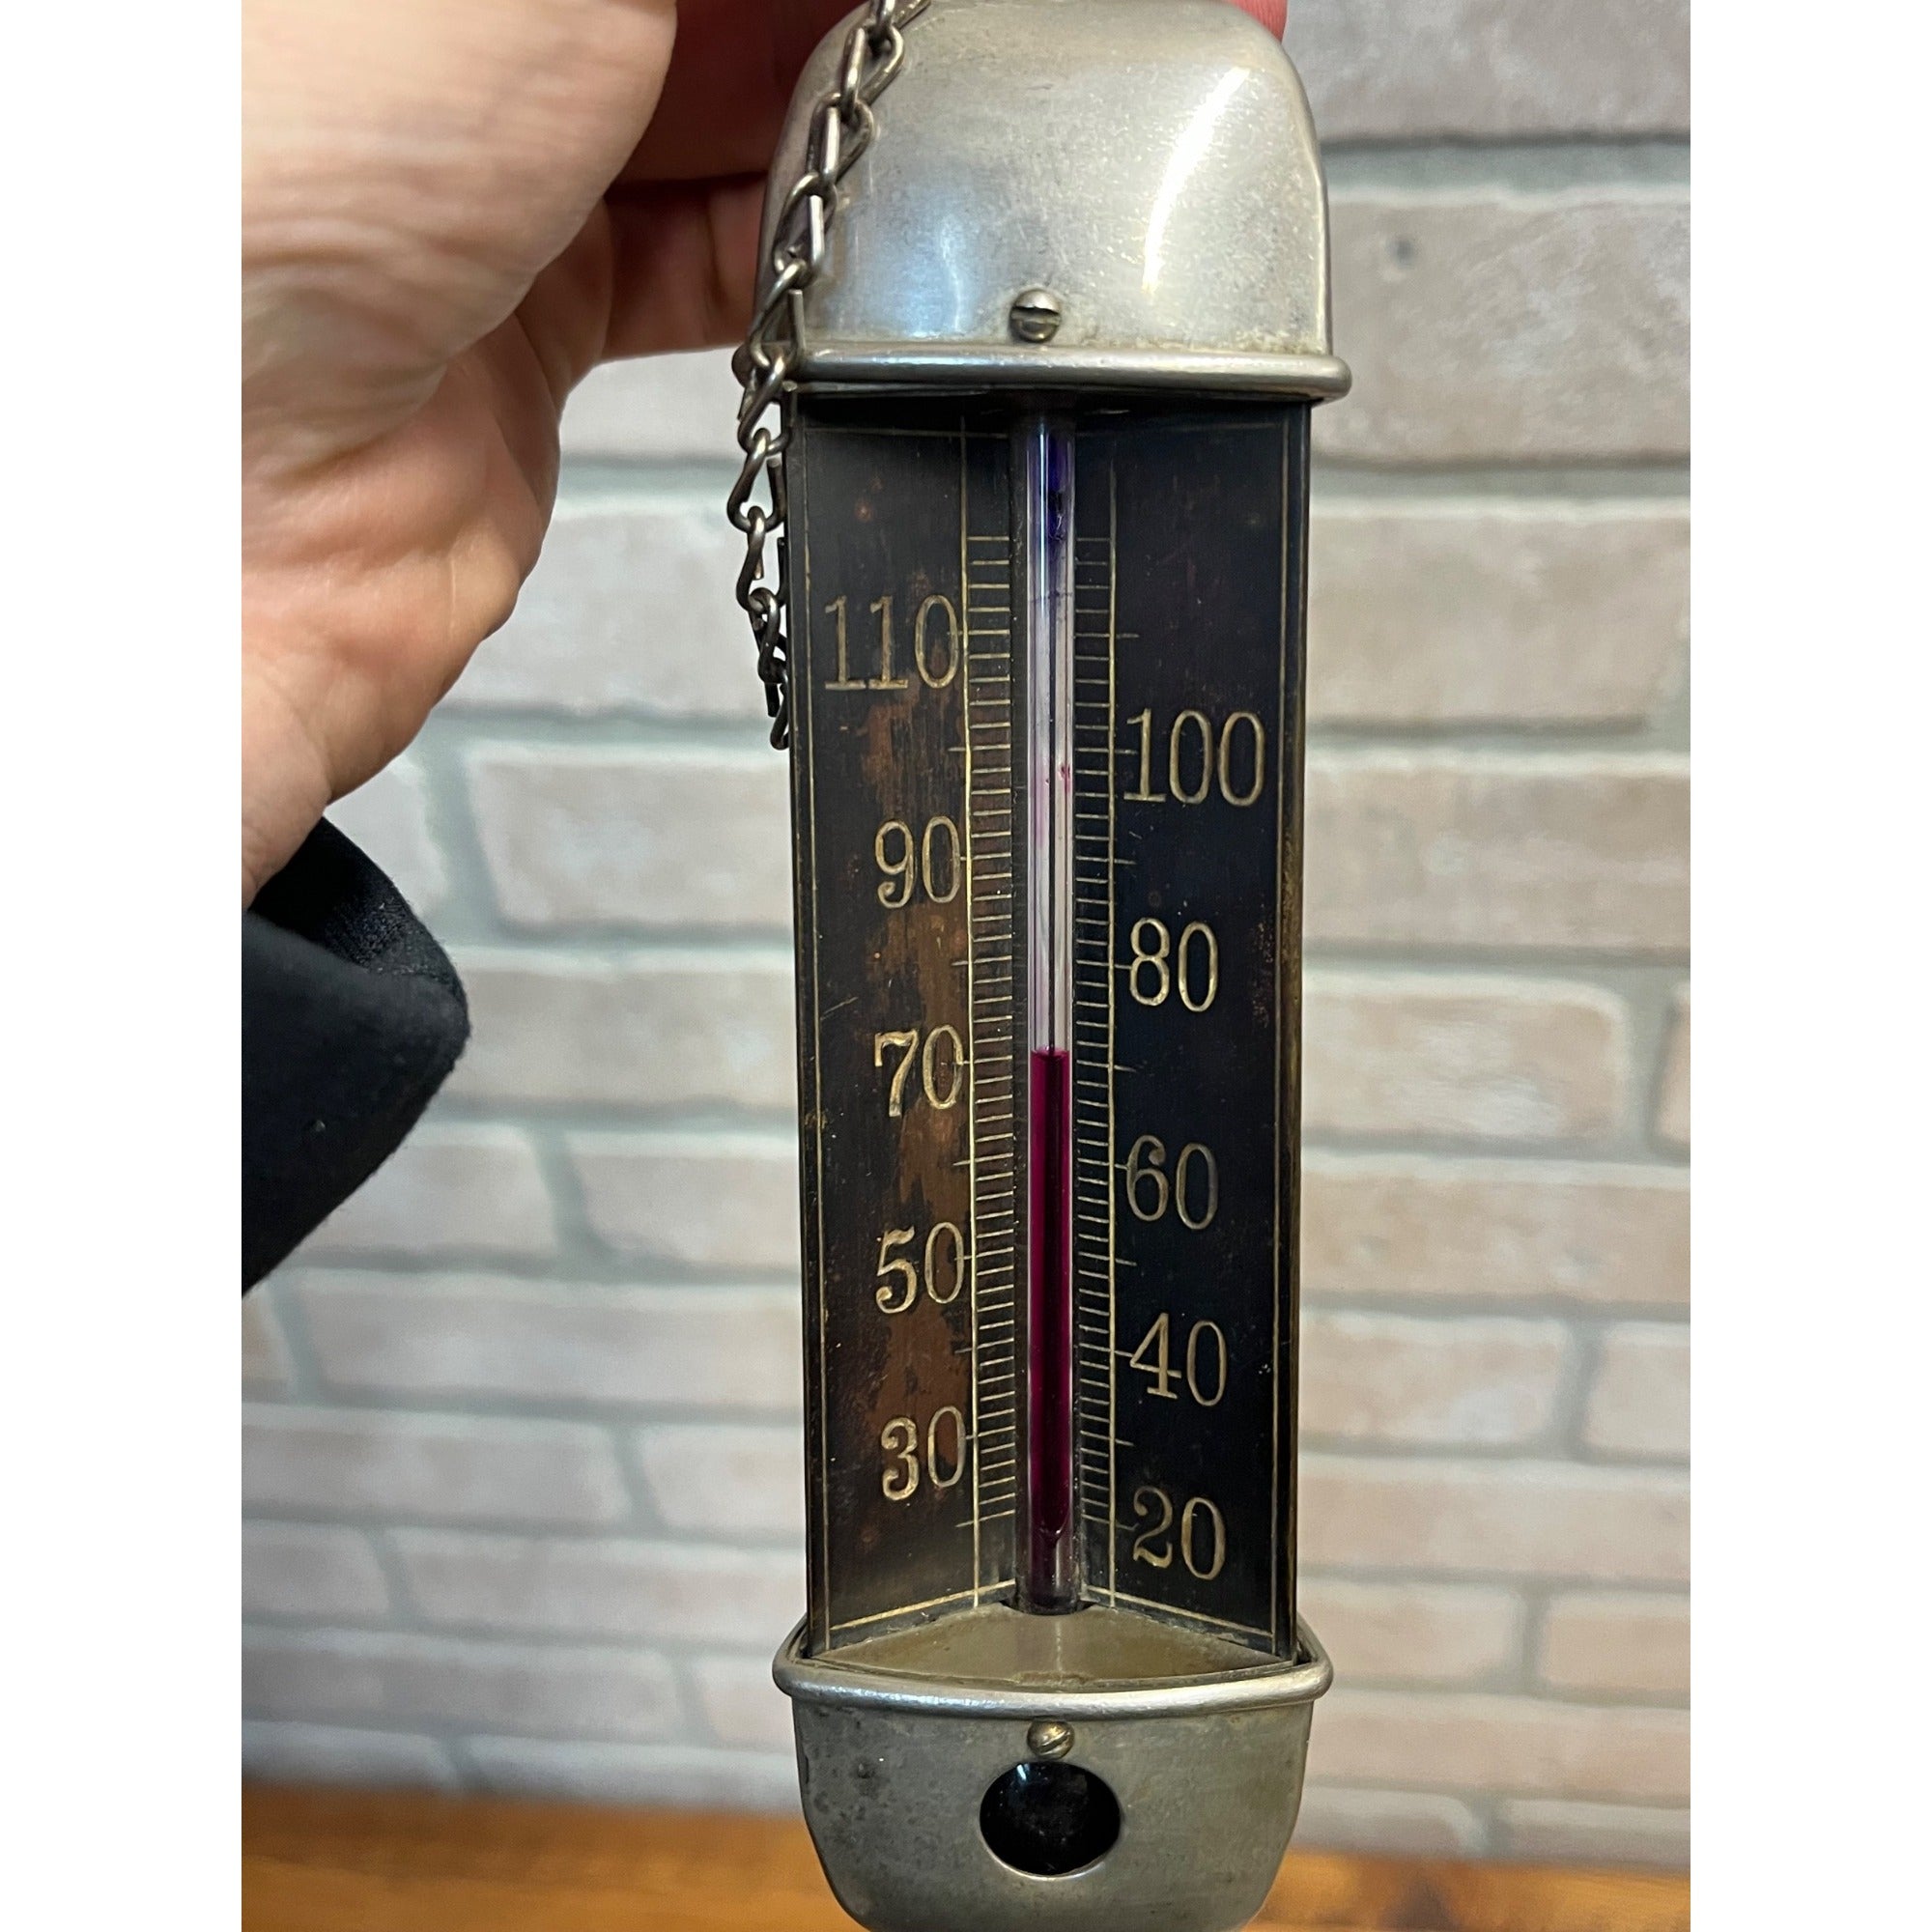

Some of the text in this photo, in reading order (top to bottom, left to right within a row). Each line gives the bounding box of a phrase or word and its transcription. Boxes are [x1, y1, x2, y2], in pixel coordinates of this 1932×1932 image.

[825, 595, 960, 690] 110
[1123, 708, 1265, 808] 100
[874, 816, 961, 909] 90
[1129, 918, 1218, 1012] 80
[874, 1025, 964, 1117] 70
[1126, 1134, 1219, 1231] 60
[875, 1221, 964, 1314] 50
[1128, 1313, 1228, 1407] 40
[881, 1406, 966, 1501] 30
[1132, 1485, 1226, 1580] 20
